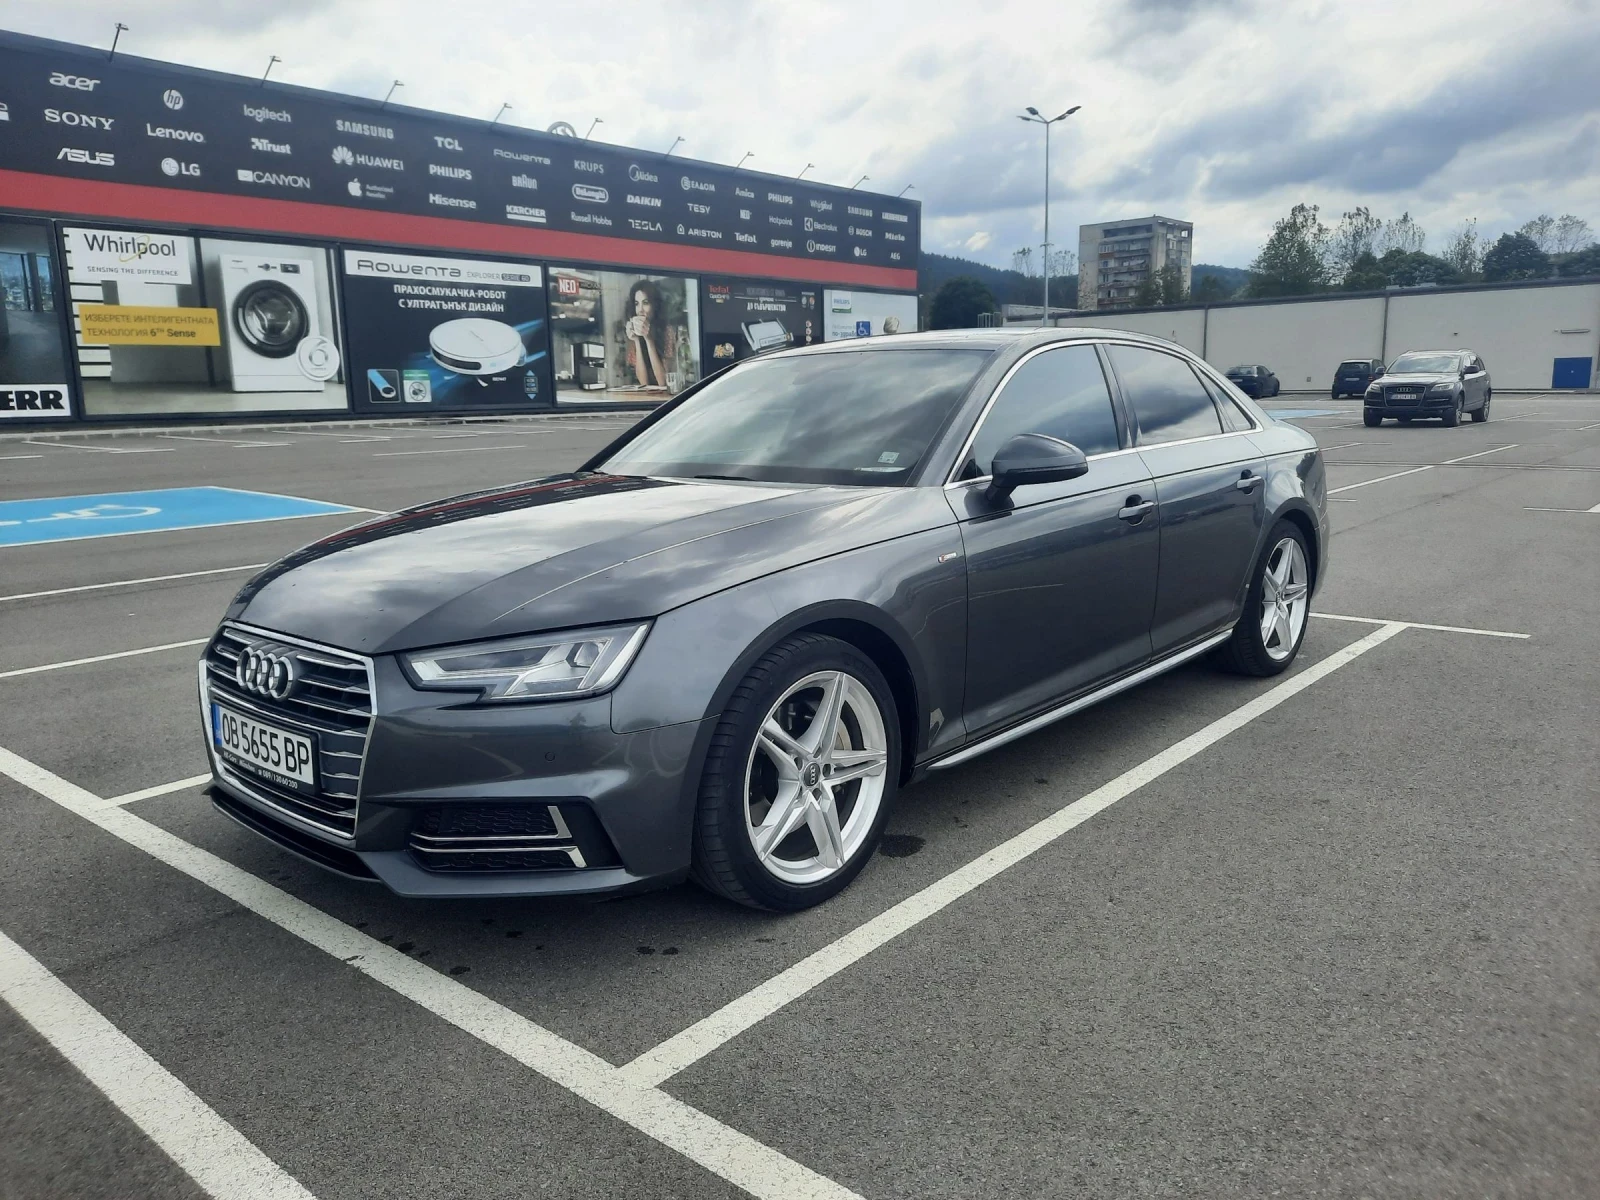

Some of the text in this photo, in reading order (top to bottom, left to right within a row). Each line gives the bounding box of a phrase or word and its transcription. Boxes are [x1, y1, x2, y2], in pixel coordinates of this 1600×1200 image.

[49, 72, 101, 92] acer
[163, 89, 184, 111] hp
[44, 108, 115, 131] SONY
[243, 104, 292, 123] logitech
[146, 123, 205, 143] Lenovo
[336, 119, 394, 139] SAMSUNG
[261, 139, 292, 155] Trust
[434, 136, 463, 151] TCL
[56, 147, 115, 167] ASUS
[356, 153, 404, 171] HUAWEI
[493, 148, 551, 165] Rowenta
[181, 161, 201, 176] LG
[429, 164, 472, 180] PHILIPS
[574, 159, 604, 174] KRUPS
[253, 171, 311, 190] CANYON
[511, 173, 538, 190] BRAUN
[634, 170, 659, 183] Midea
[429, 193, 477, 209] Hisense
[626, 194, 662, 208] DAIKIN
[767, 192, 794, 205] PHILIPS
[687, 202, 711, 214] TESY
[847, 205, 873, 218] SAMSUNG
[592, 214, 613, 226] Hobbs
[628, 218, 663, 232] TESLA
[687, 227, 723, 239] ARISTON
[734, 231, 758, 244] Tefal
[855, 227, 873, 237] BOSCH
[83, 233, 177, 260] Whirlpool
[769, 237, 793, 249] gorenje
[890, 251, 901, 261] AEG
[86, 265, 179, 277] SENSING THE DIFFERENCE
[356, 258, 462, 279] Rowenta
[393, 283, 507, 300] ПРАХОСМУКАЧКА-РОБОТ
[558, 278, 578, 294] NEO
[708, 284, 731, 295] Tefal
[398, 298, 505, 313] С УЛТРАТЪНЪК ДИЗАЙН
[85, 314, 131, 323] ИЗБЕРЕТЕ
[87, 328, 149, 337] ТЕХНОЛОГИЯ
[166, 329, 197, 338] Sense
[223, 714, 309, 775] OB 5655 BP
